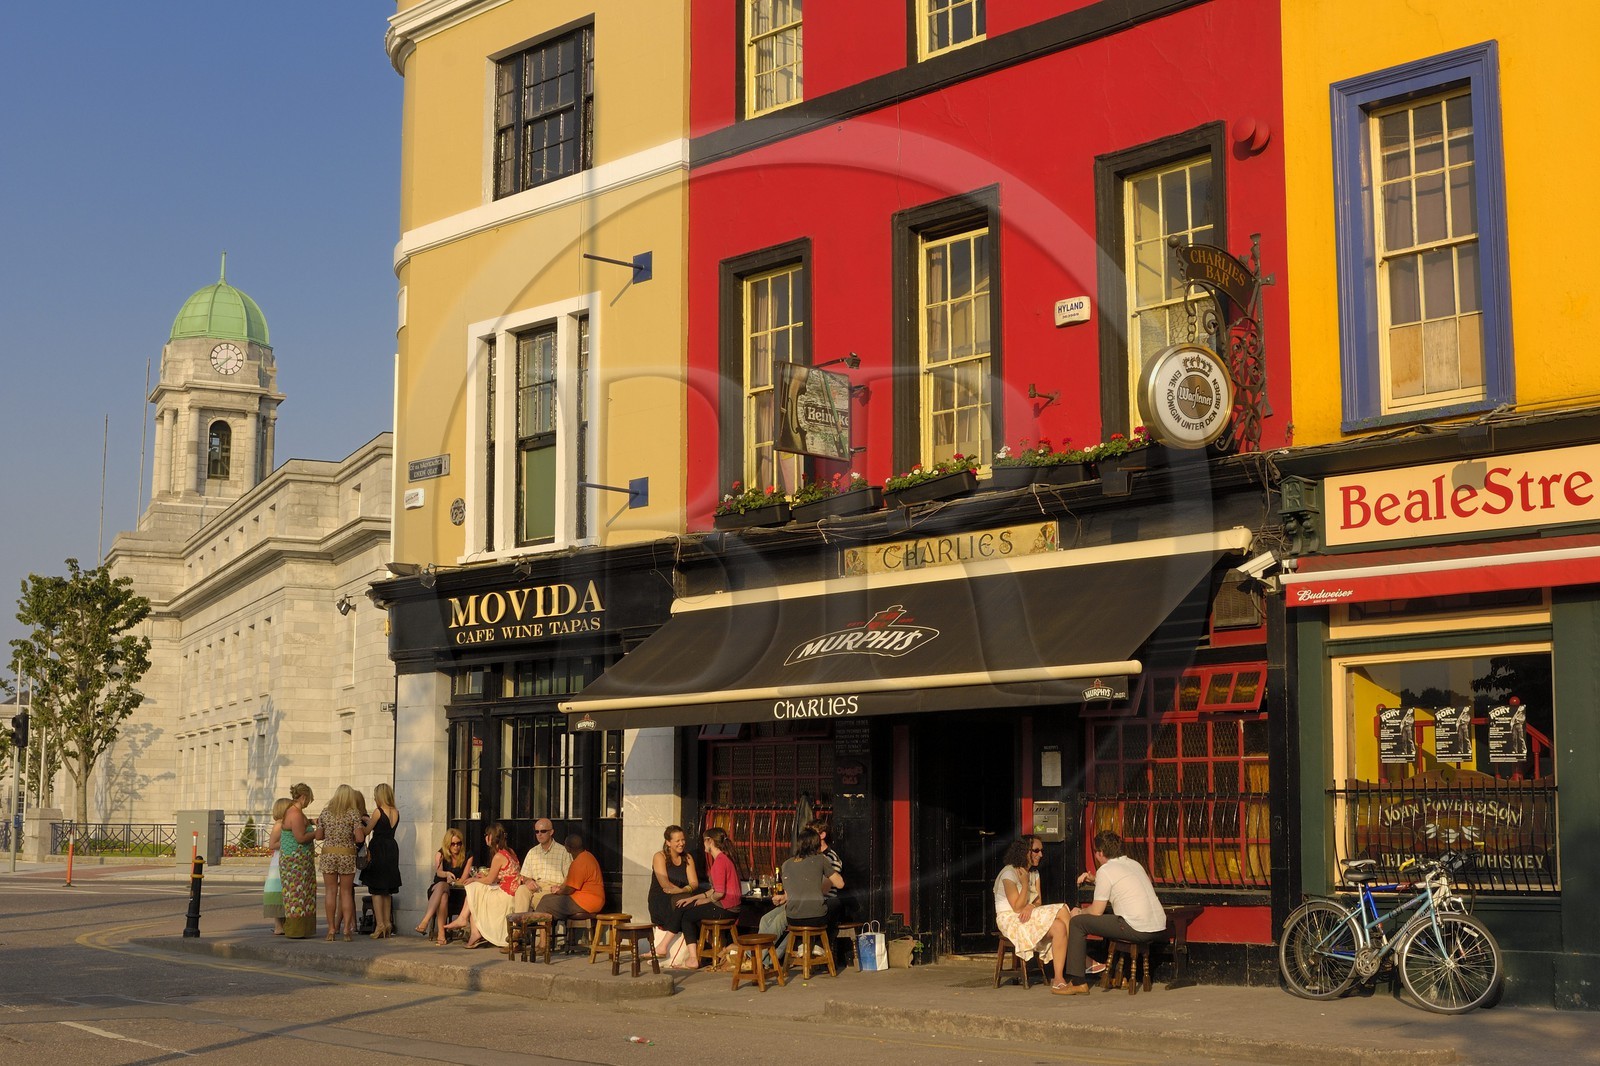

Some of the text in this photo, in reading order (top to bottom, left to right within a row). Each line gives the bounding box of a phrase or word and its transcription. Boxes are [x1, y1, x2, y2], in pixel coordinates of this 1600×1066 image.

[1190, 250, 1246, 287] CHARLIES
[1206, 265, 1230, 288] BAR
[1057, 301, 1084, 314] HYLAND
[1166, 369, 1221, 431] EINE KÖNIGIN UNTER DEN BIEREN
[882, 530, 1013, 569] CHARLIES
[448, 580, 606, 629] MOVIDA
[1297, 588, 1354, 602] Budweiser
[456, 617, 601, 645] CAFE WINE TAPAS
[1380, 709, 1401, 723] RORY
[1435, 708, 1456, 721] RORY
[1489, 706, 1511, 720] RORY
[1384, 803, 1419, 826] JOHN
[1475, 854, 1544, 869] WHISKEY
